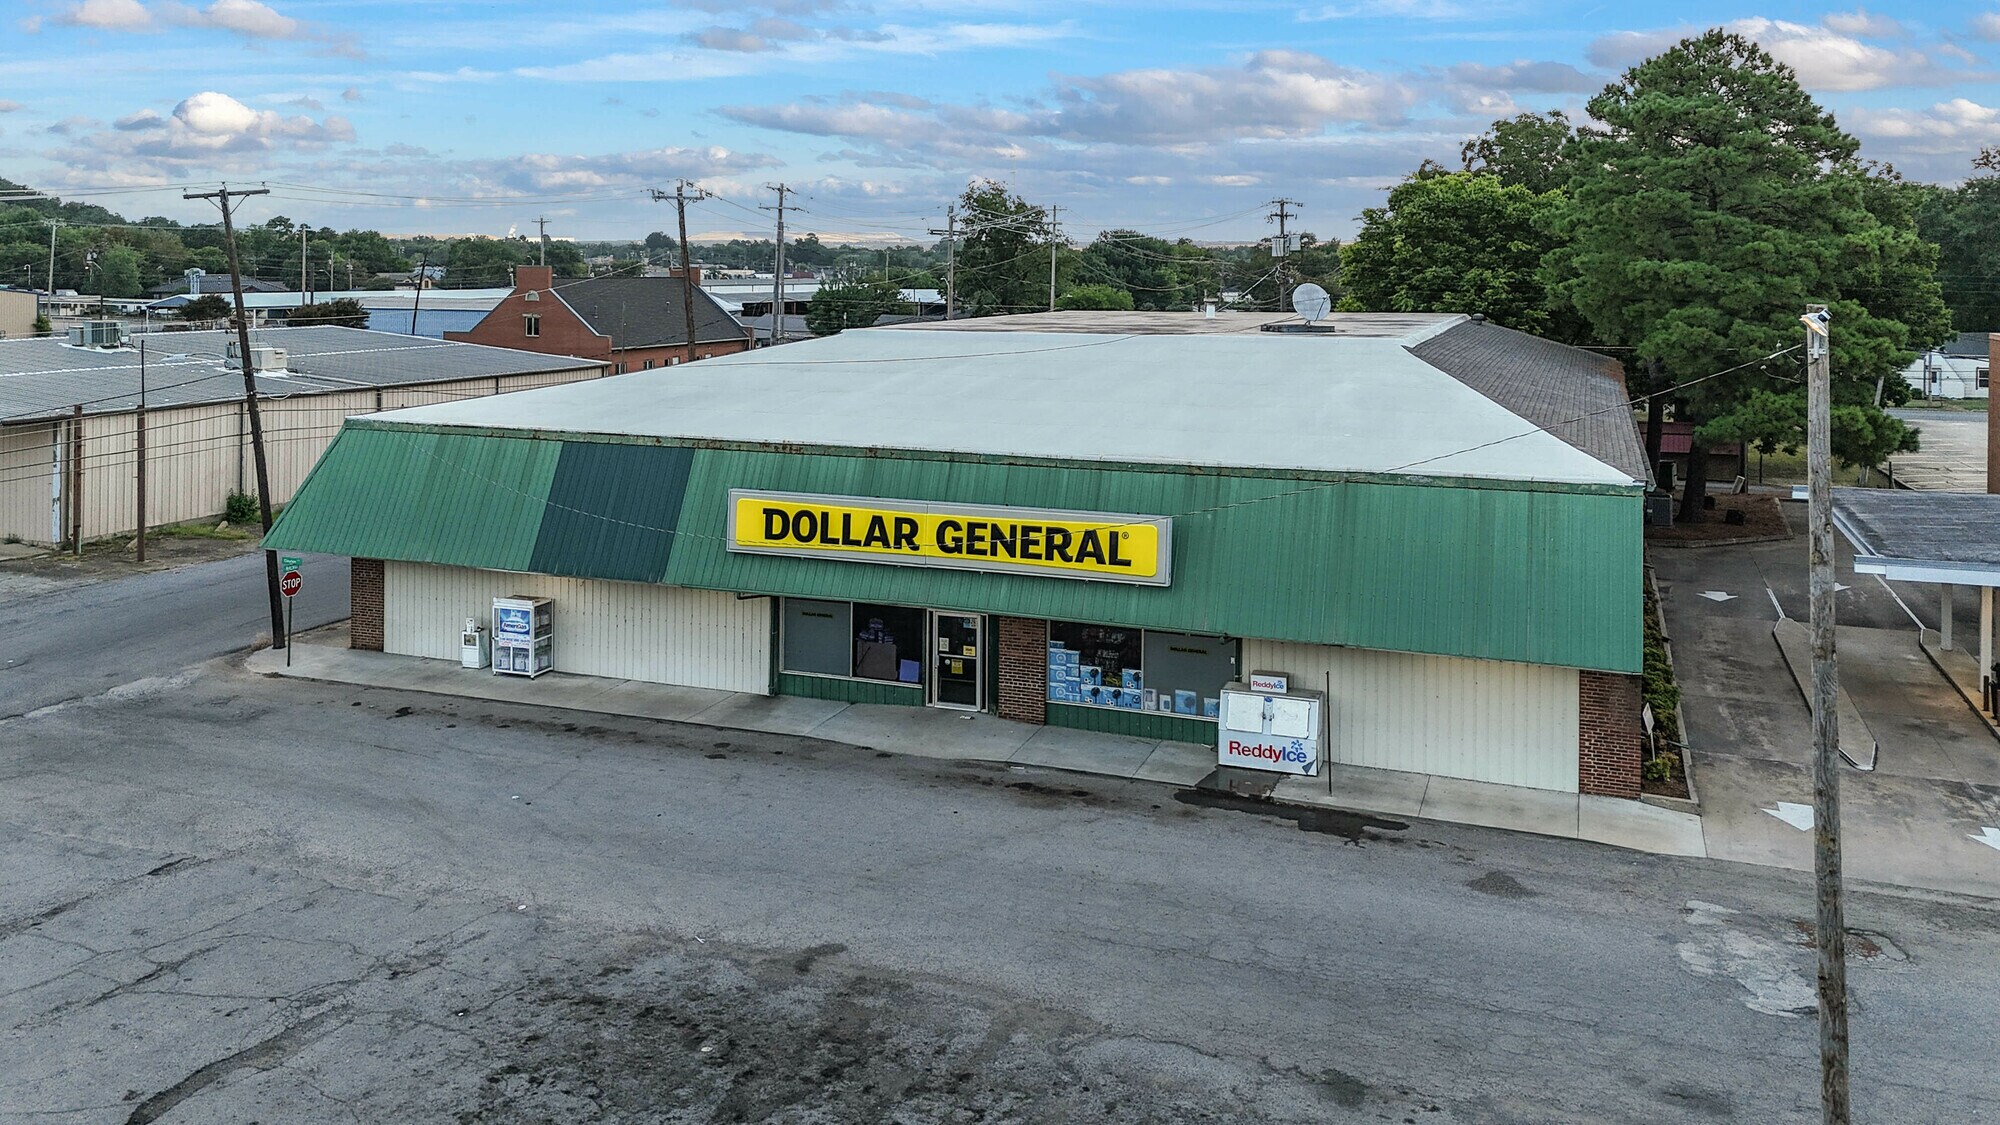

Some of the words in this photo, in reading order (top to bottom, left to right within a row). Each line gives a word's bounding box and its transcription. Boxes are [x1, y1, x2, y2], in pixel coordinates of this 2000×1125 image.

[762, 507, 920, 551] DOLLAR
[282, 577, 301, 590] STOP
[1228, 740, 1308, 763] ReddyIce
